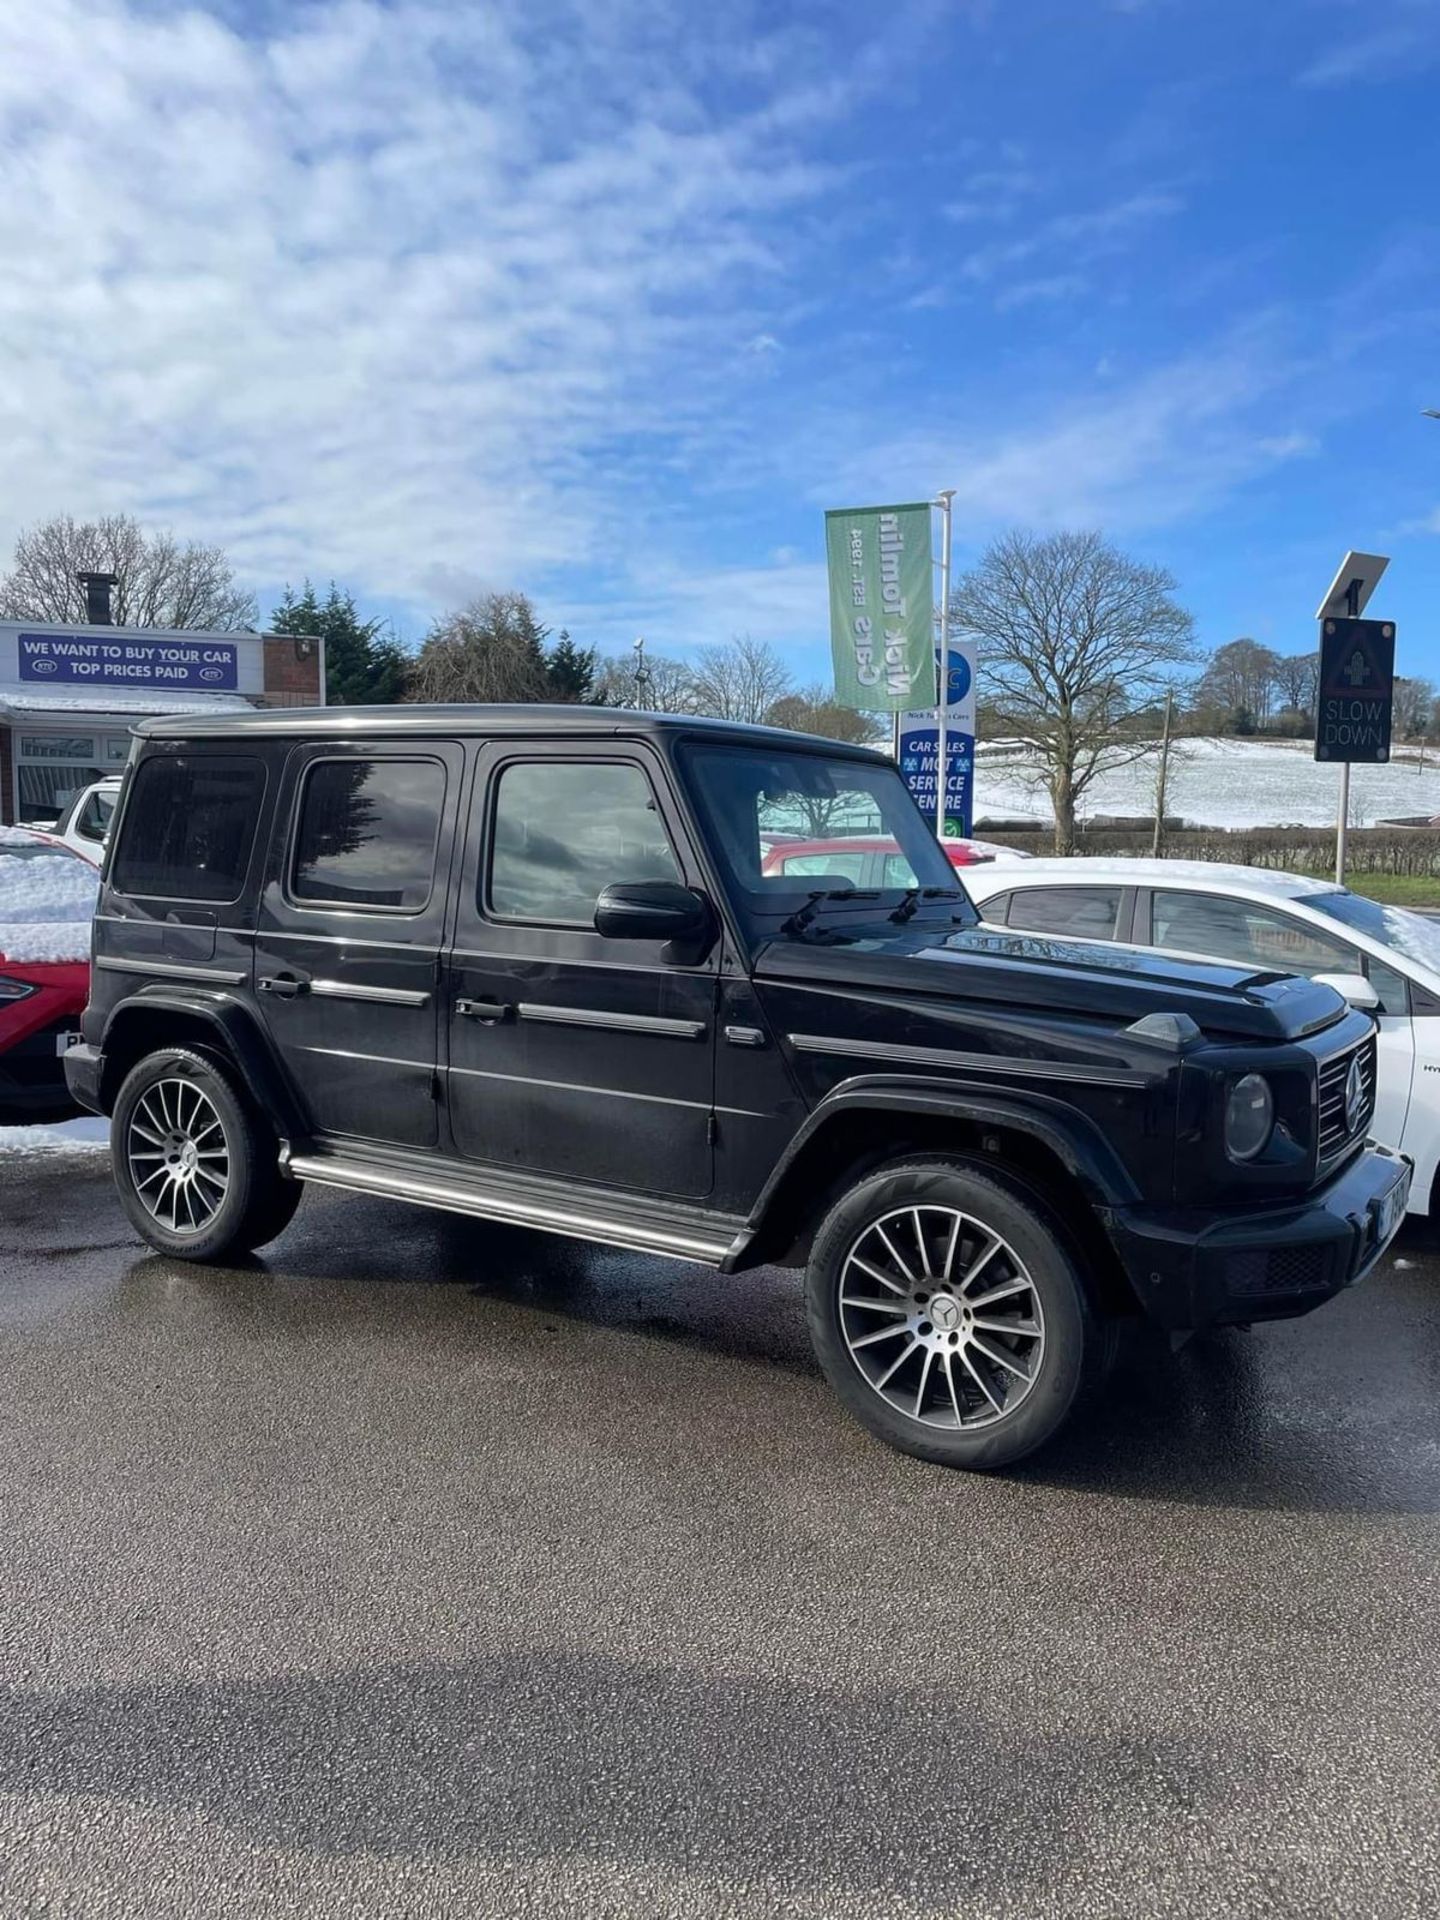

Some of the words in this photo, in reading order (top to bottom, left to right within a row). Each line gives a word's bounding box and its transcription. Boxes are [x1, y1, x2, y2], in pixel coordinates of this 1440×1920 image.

[24, 641, 49, 654] WE
[52, 643, 98, 656] WANT
[101, 646, 121, 658] TO
[125, 647, 155, 659] BUY
[159, 649, 199, 662] YOUR
[203, 651, 231, 663] CAR
[70, 662, 100, 675] TOP
[104, 664, 151, 677] PRICES
[155, 666, 188, 679] PAID
[1326, 700, 1383, 720] SLOW
[1325, 724, 1382, 745] DOWN
[909, 741, 931, 752] CAR
[933, 742, 965, 753] SLES
[913, 794, 962, 809] ENRE
